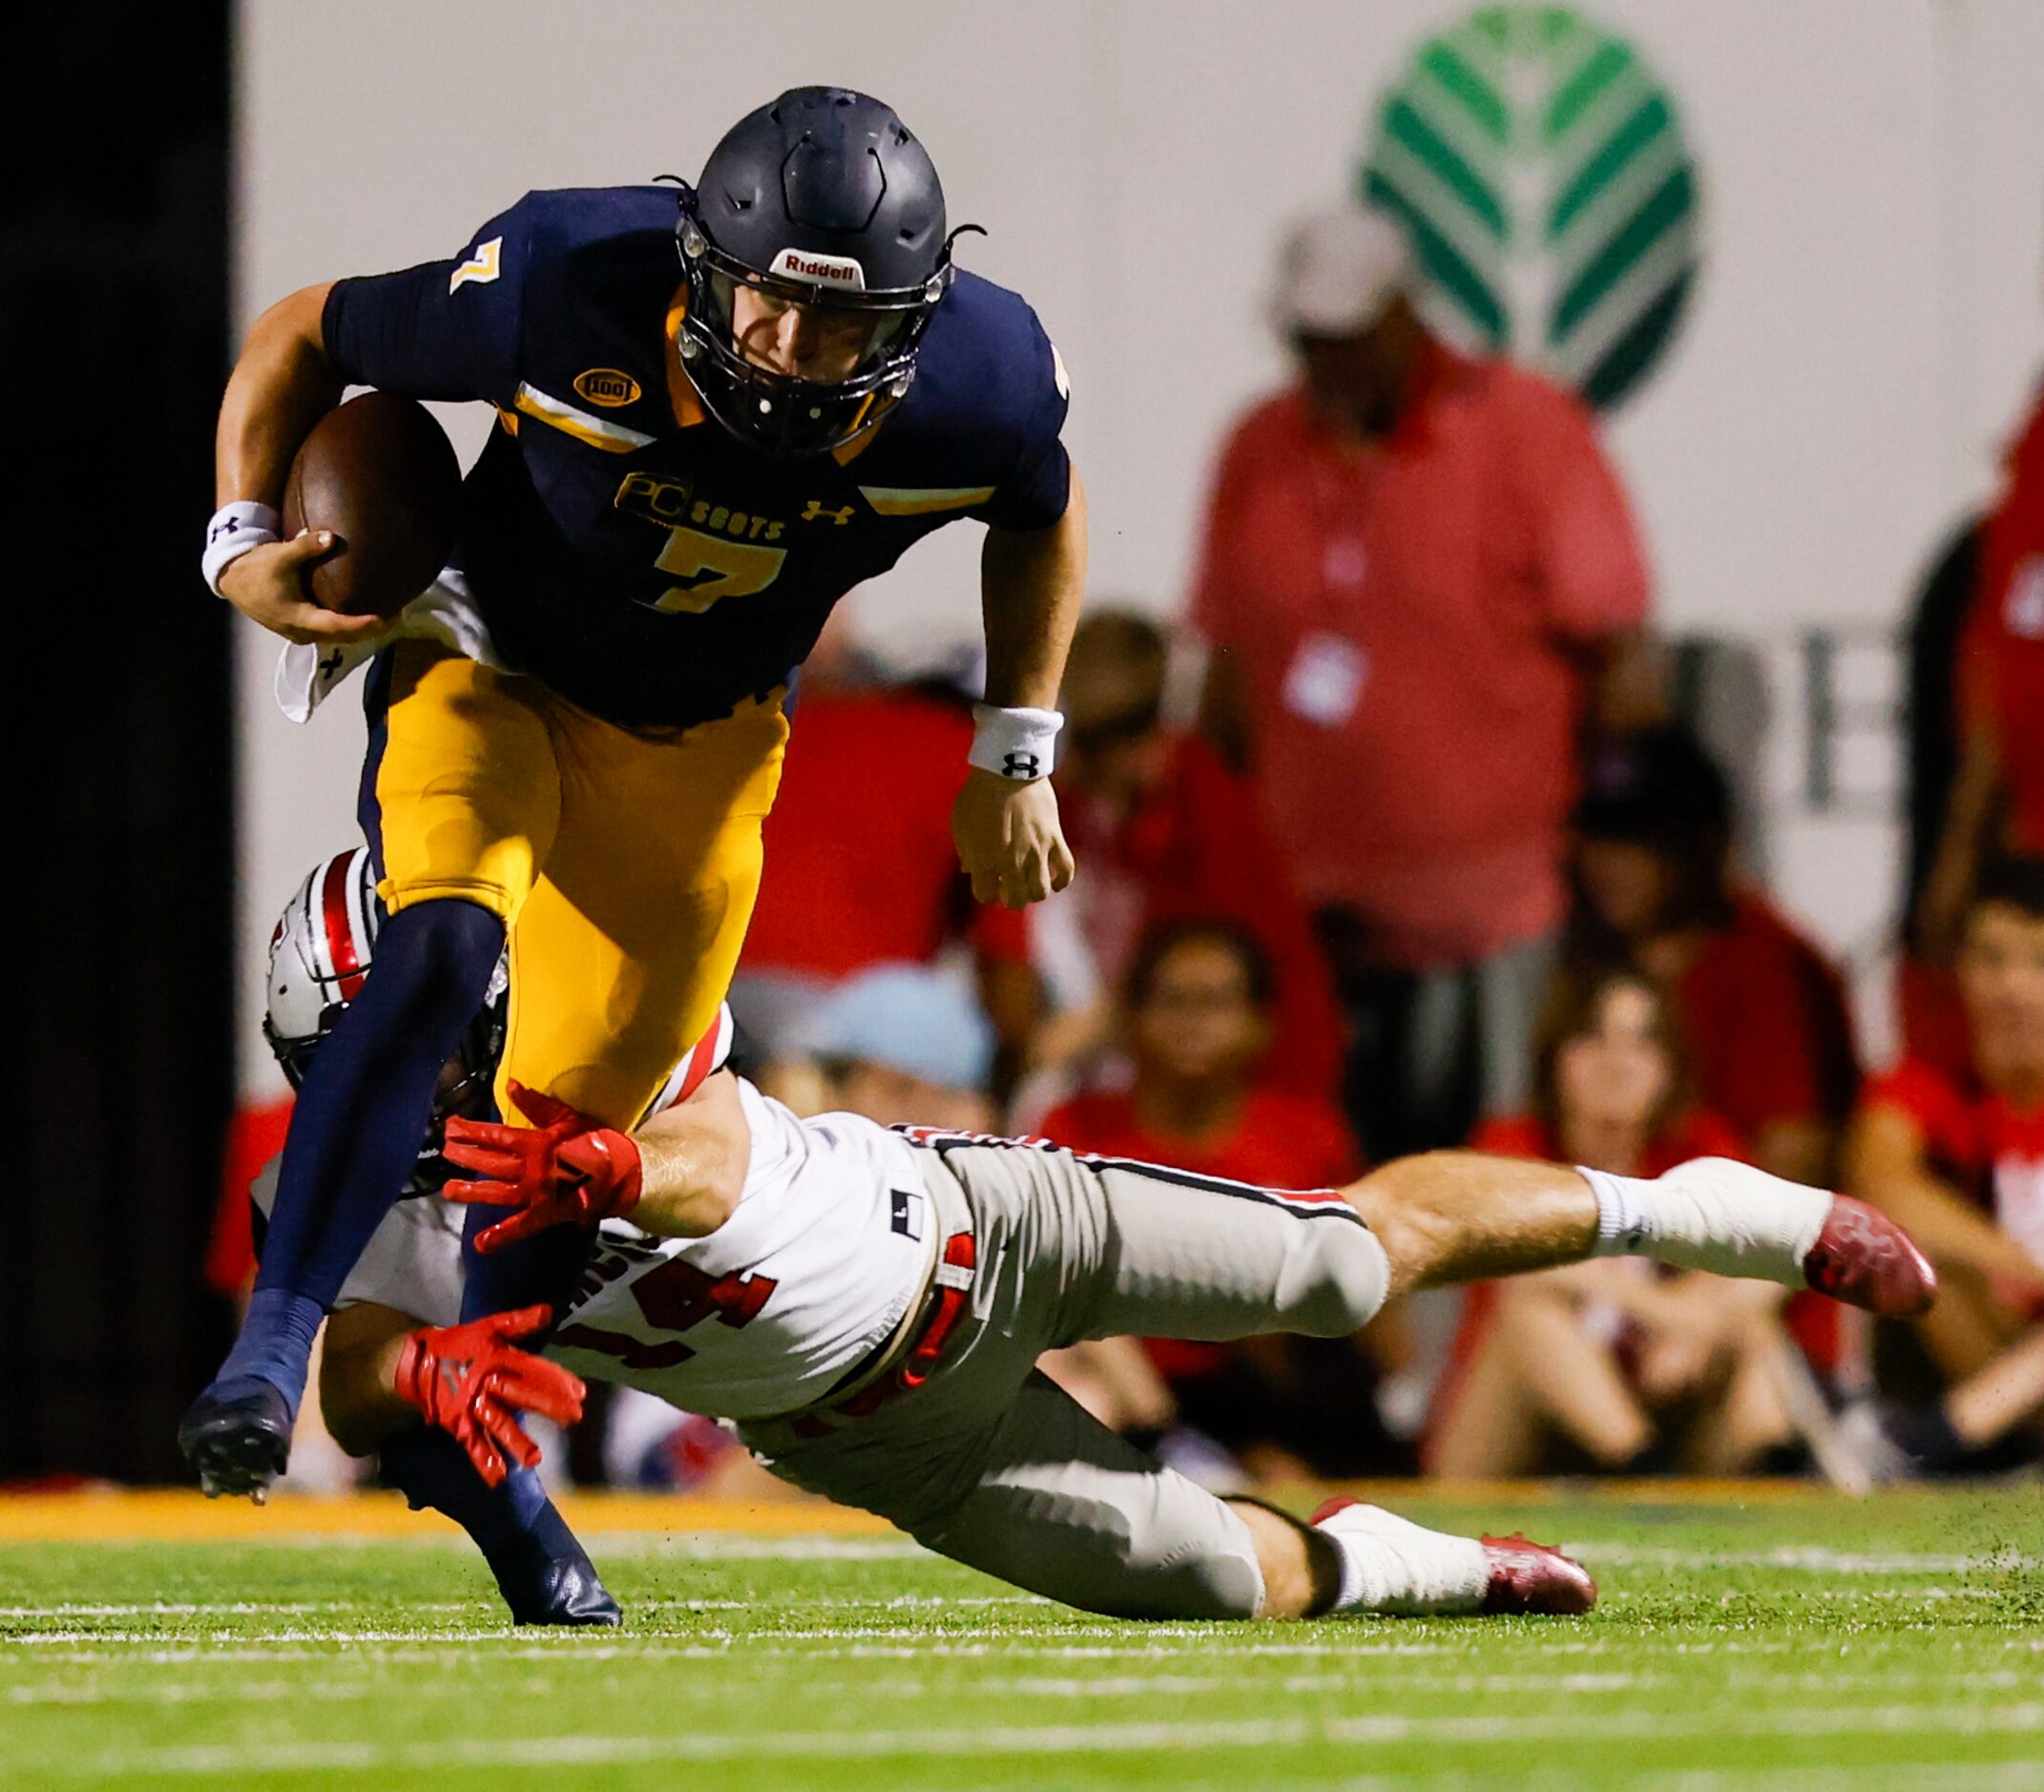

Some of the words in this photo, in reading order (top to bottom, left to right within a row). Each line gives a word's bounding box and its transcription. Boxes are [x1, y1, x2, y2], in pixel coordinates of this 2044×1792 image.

[448, 235, 503, 296] 7
[785, 254, 855, 281] Riddell
[590, 378, 627, 399] 100
[691, 499, 785, 541] SCOTS
[654, 526, 789, 613] 7
